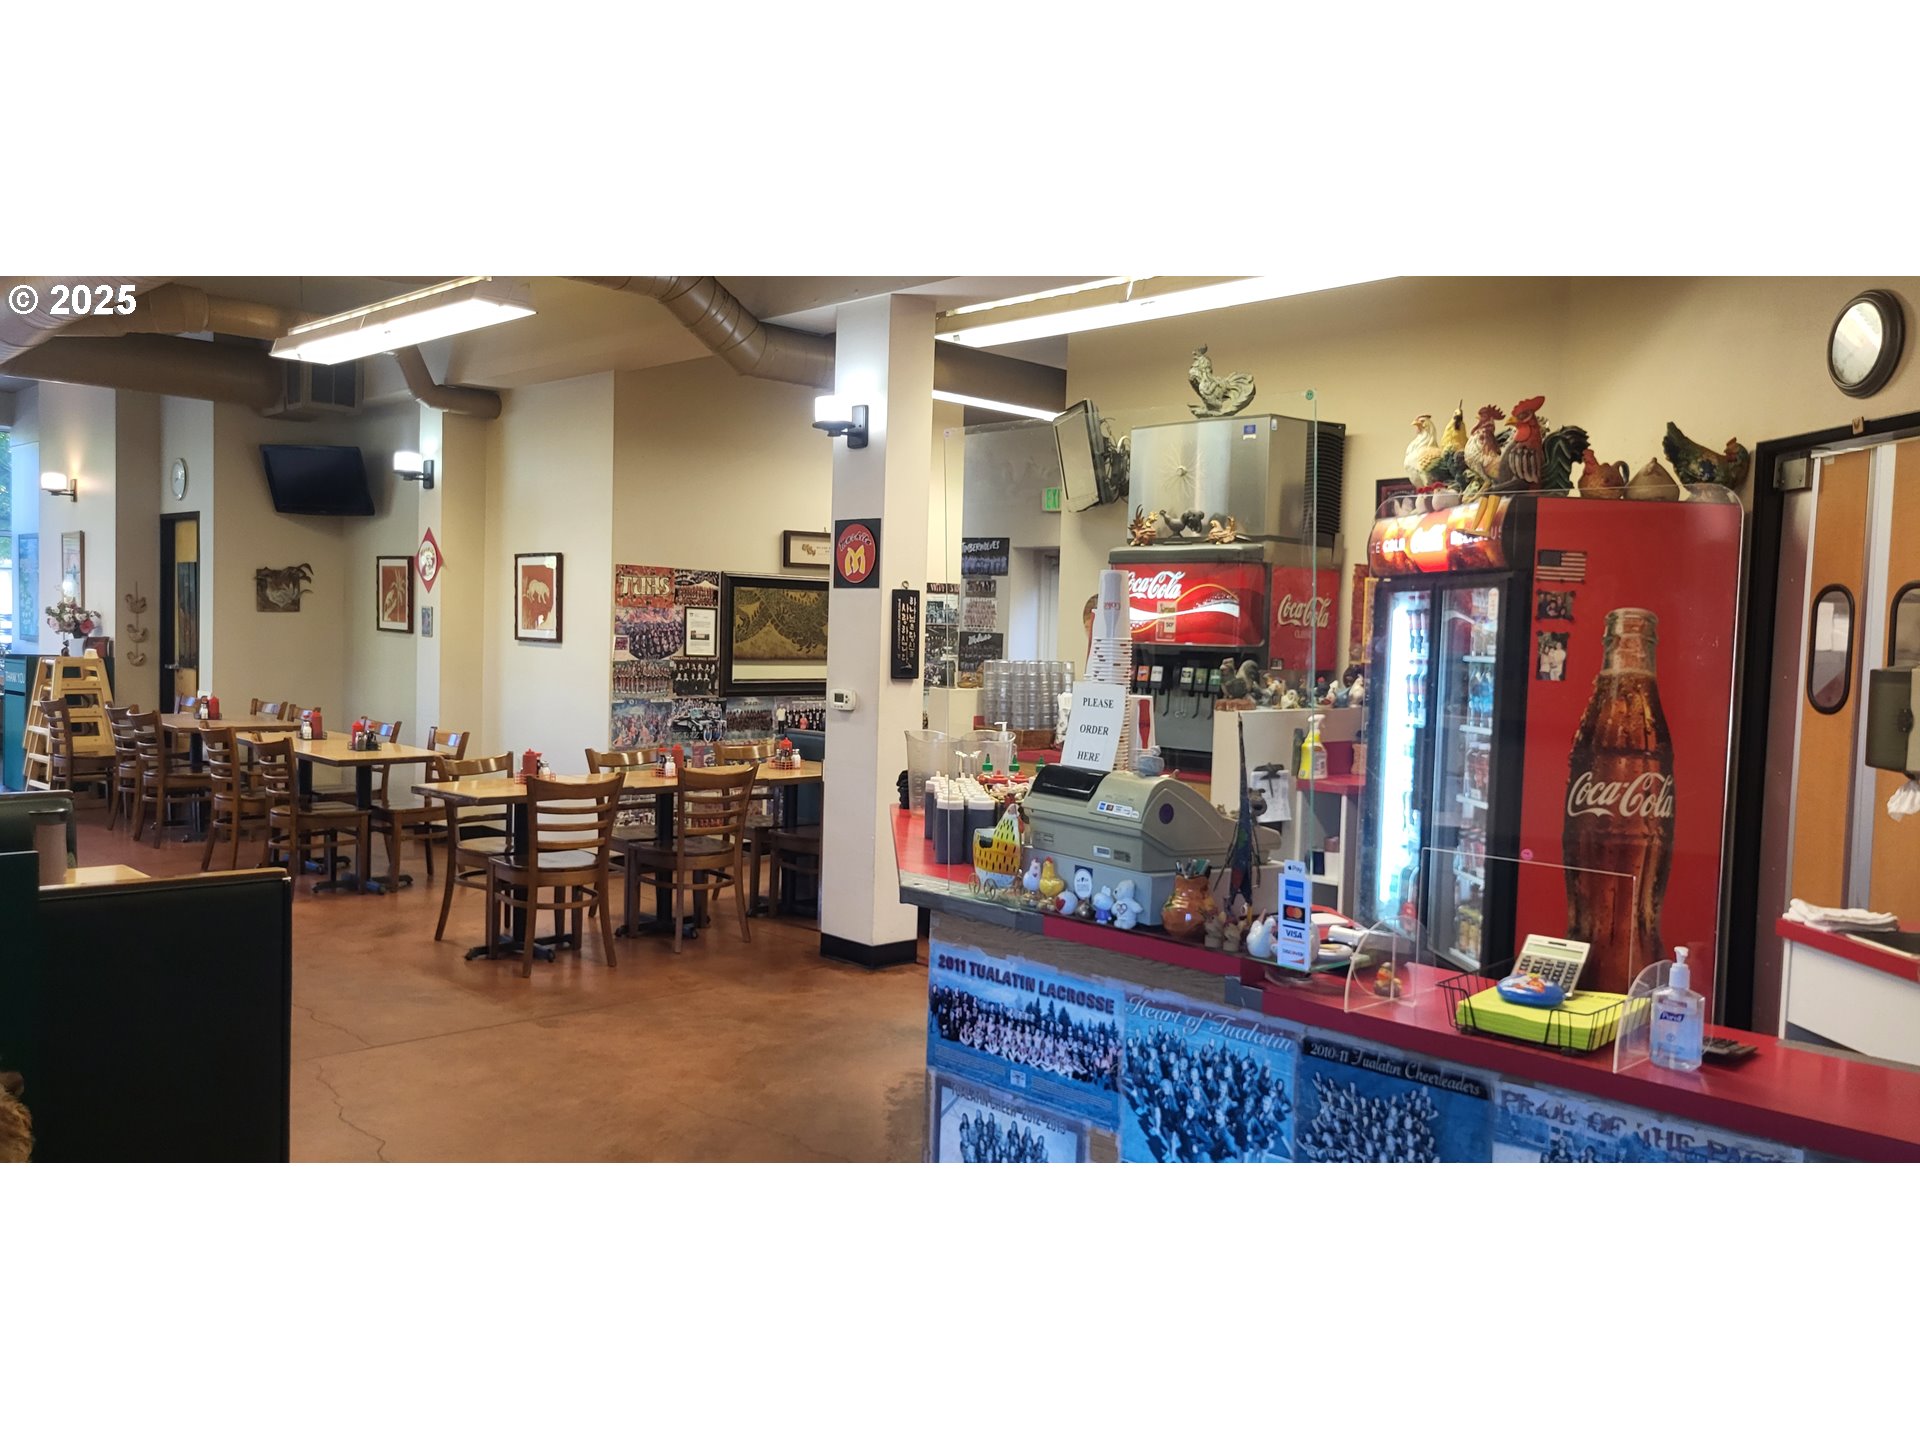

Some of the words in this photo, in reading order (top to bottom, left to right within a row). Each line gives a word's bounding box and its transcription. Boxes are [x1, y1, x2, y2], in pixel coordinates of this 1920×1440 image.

[1045, 488, 1060, 510] EXI
[962, 541, 1000, 553] MBERWOLVES
[620, 575, 671, 596] TUHS
[1128, 570, 1186, 600] oca-Cola
[1277, 593, 1332, 629] Coca-Cola
[1082, 696, 1115, 709] PLEASE
[1079, 723, 1110, 736] ORDER
[1077, 750, 1101, 762] HERE
[1567, 771, 1674, 818] Coca-Cola
[1286, 929, 1303, 939] VISA
[938, 953, 967, 975] 2011
[969, 961, 1036, 993] TUALATIN
[1038, 980, 1115, 1015] LACROSSE
[1125, 996, 1183, 1024] Heart
[1183, 1012, 1213, 1037] of
[1209, 1014, 1293, 1051] Tualatin
[1309, 1042, 1349, 1064] 2010-11
[1350, 1048, 1401, 1076] Tualatin
[1404, 1059, 1481, 1096] Cheerleaders
